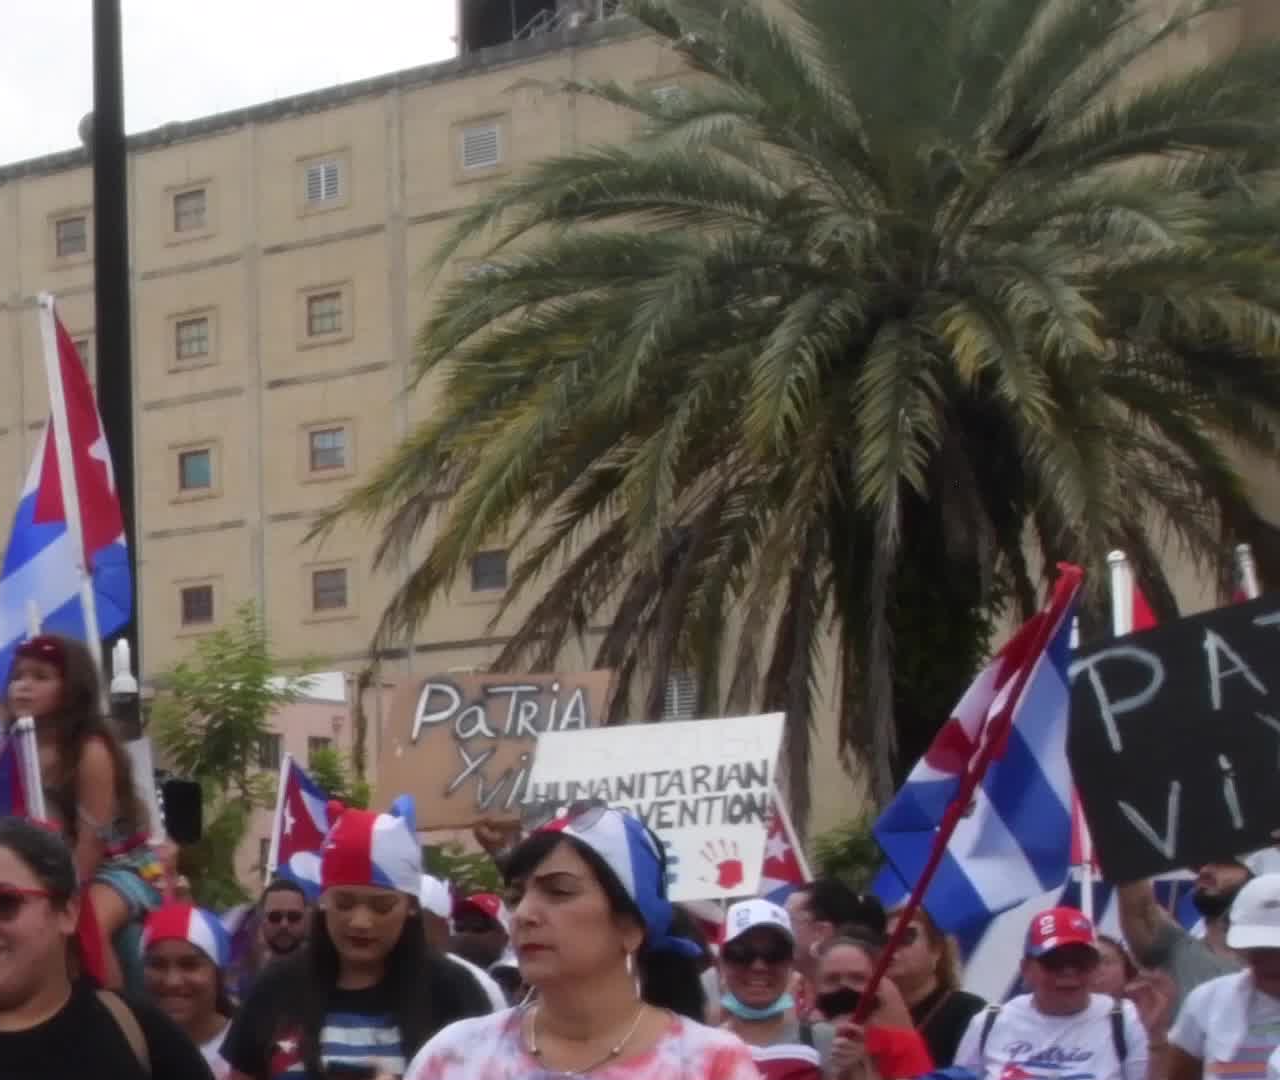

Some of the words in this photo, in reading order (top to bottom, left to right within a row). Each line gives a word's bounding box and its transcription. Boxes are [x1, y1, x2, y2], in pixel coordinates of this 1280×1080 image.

[1067, 611, 1280, 753] PA
[531, 758, 770, 804] HUMANITARIAN
[634, 790, 771, 831] VENTION
